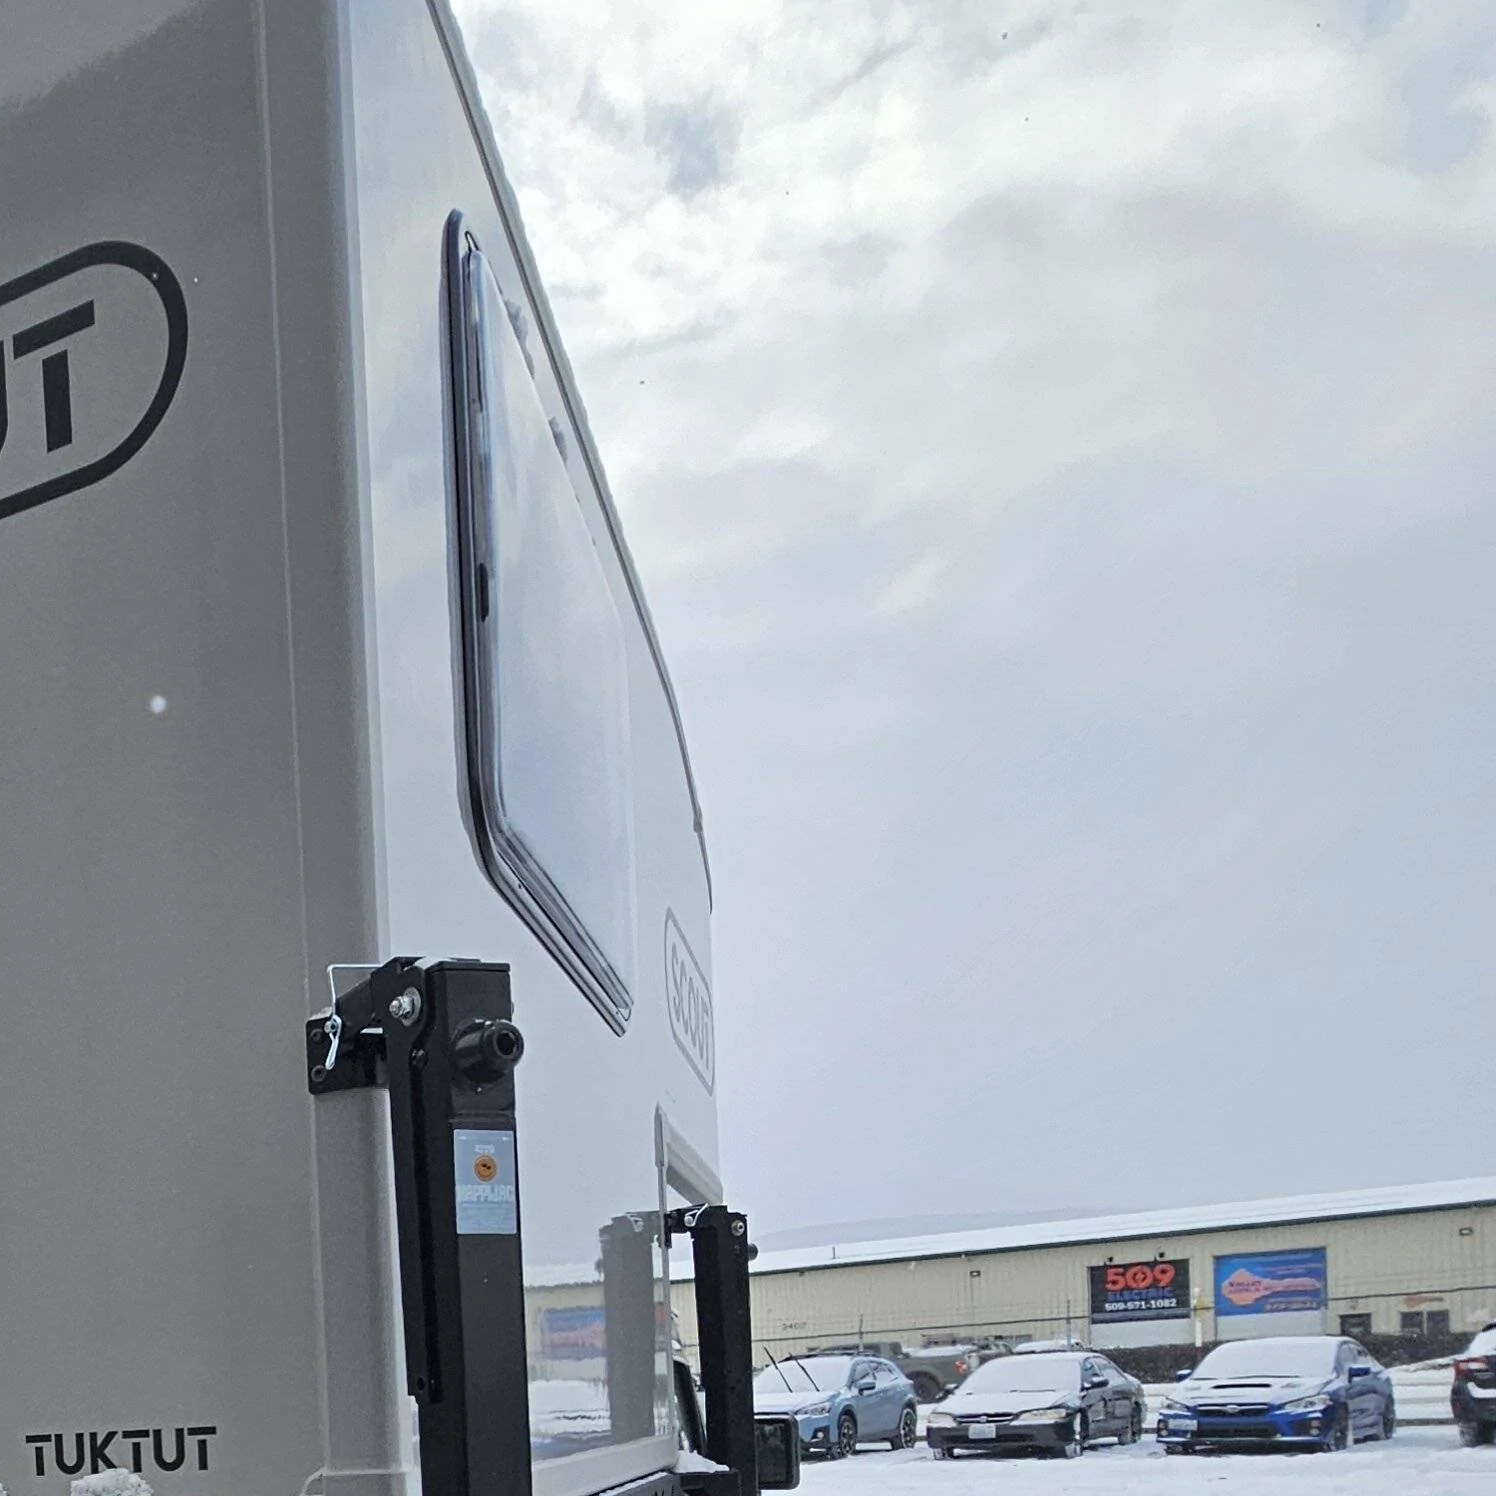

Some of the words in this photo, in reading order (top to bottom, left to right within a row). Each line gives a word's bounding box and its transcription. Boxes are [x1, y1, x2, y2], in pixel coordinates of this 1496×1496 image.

[671, 941, 709, 1070] SCOUT
[1105, 1263, 1175, 1292] 509
[1105, 1298, 1177, 1312] 509-571-1082
[25, 1425, 217, 1477] TUKTUT
